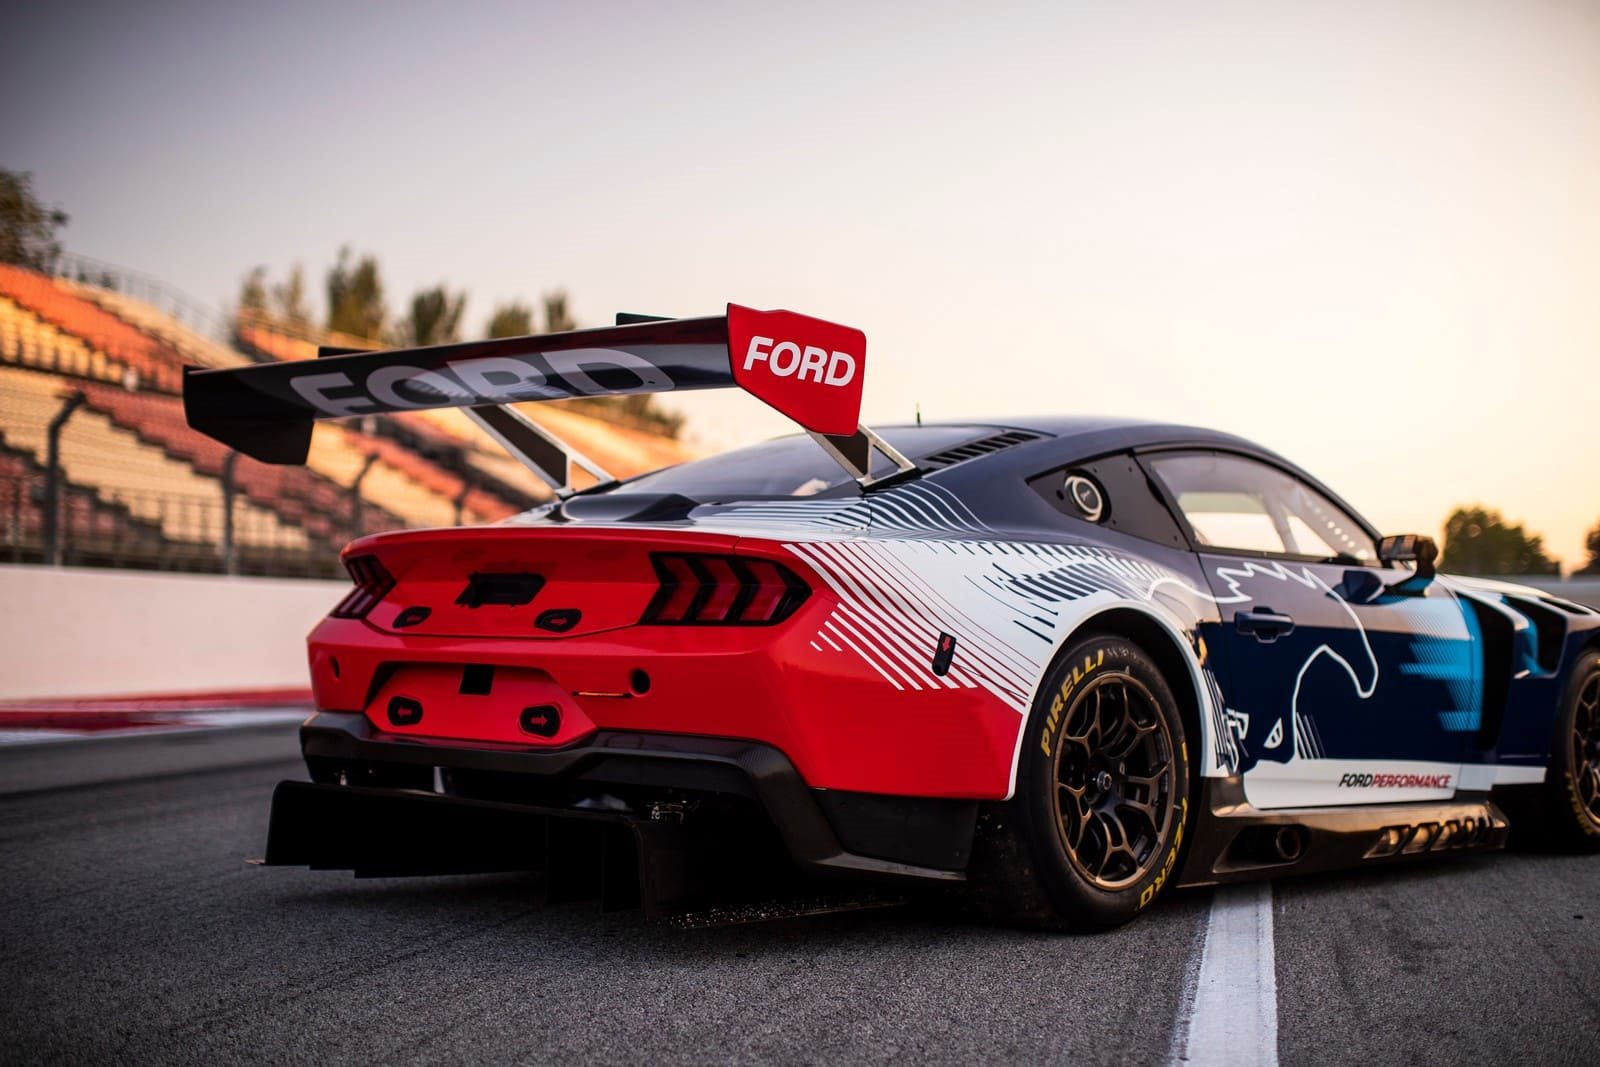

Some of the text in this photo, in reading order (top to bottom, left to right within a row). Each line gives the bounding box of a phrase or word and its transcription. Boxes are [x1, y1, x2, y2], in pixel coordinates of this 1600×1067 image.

[290, 348, 675, 417] FORD
[743, 335, 856, 387] FORD
[1040, 649, 1104, 757] PIRELLI
